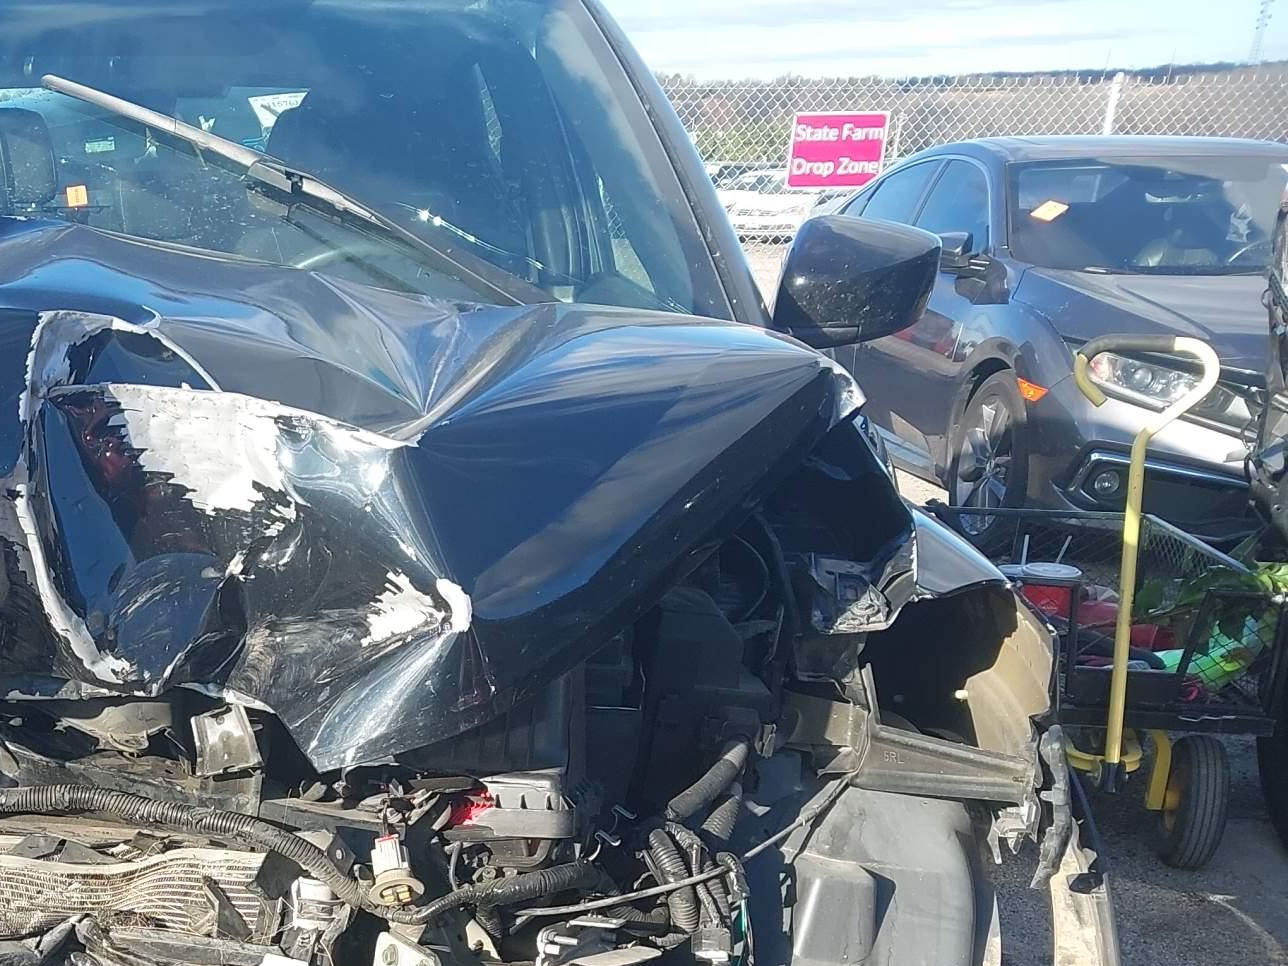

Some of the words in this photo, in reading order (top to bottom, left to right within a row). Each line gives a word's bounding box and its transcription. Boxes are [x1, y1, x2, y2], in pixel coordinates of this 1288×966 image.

[795, 123, 840, 141] State
[842, 123, 884, 141] Farm
[792, 157, 835, 177] Drop
[837, 157, 879, 175] Zone
